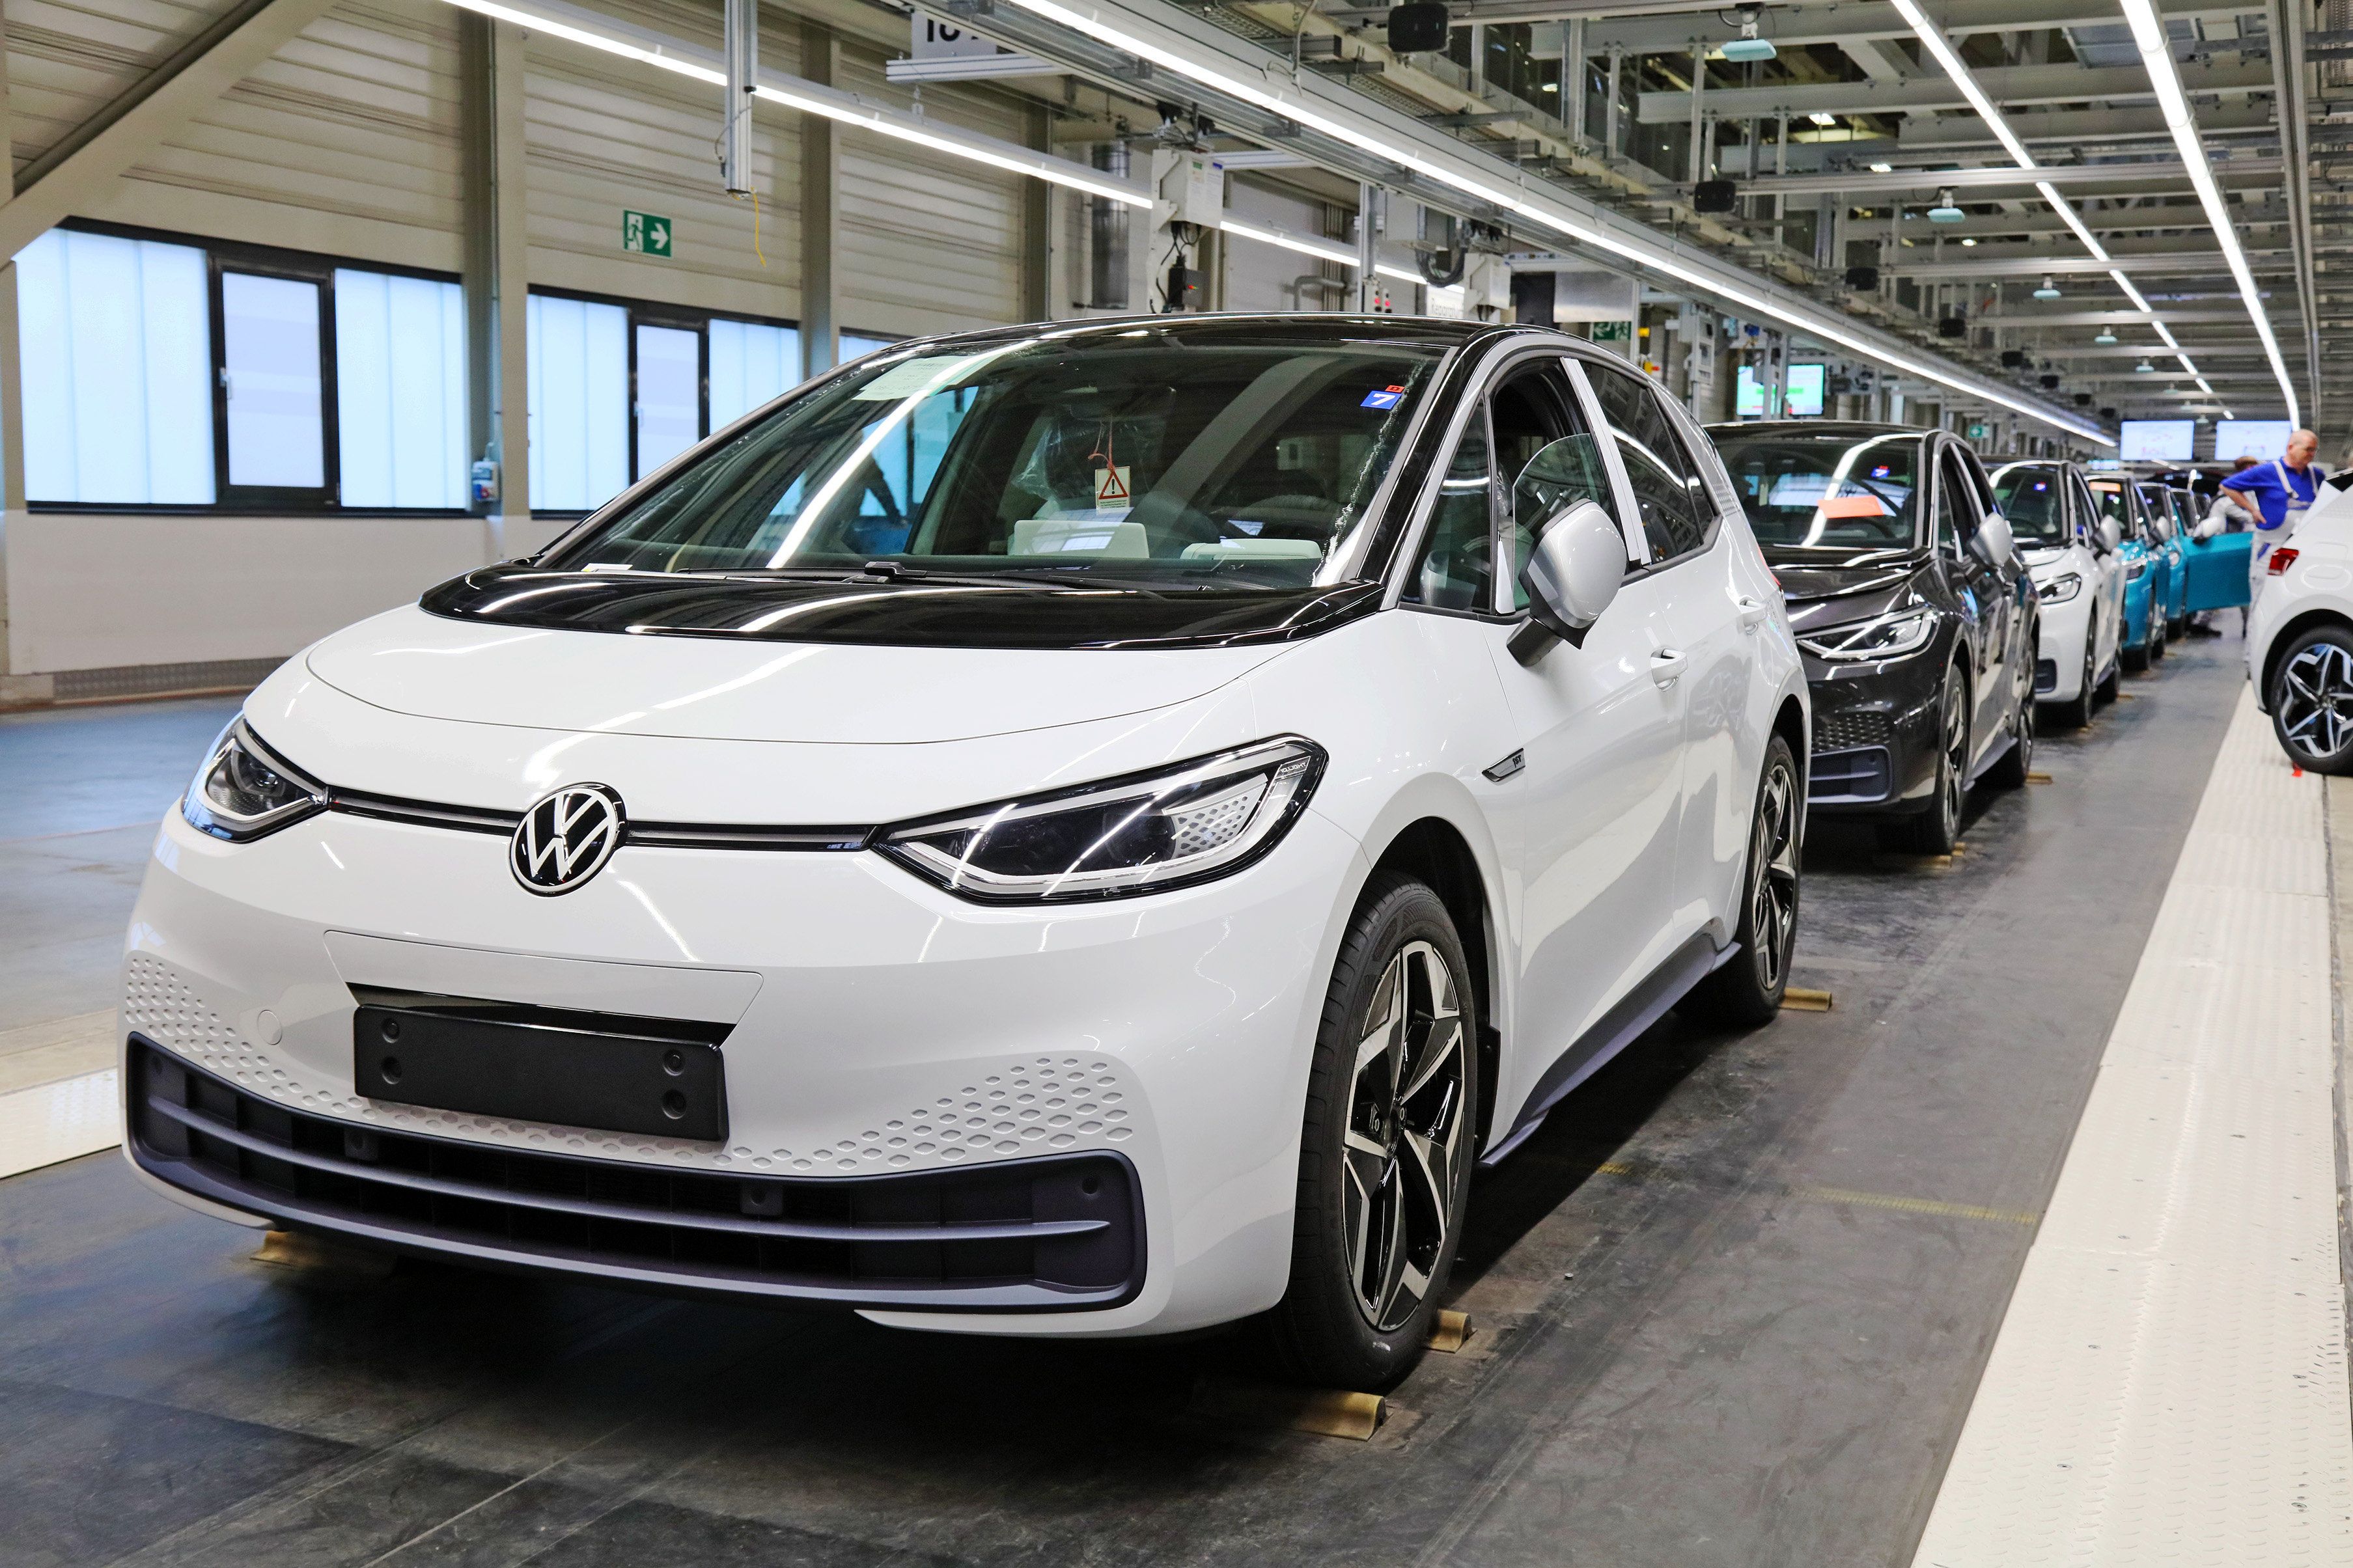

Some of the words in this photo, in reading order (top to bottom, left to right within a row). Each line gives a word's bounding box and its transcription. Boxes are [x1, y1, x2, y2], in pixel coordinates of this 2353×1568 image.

[1371, 393, 1396, 406] 7
[1280, 762, 1306, 773] IQ.LIGHT
[523, 789, 612, 884] VW
